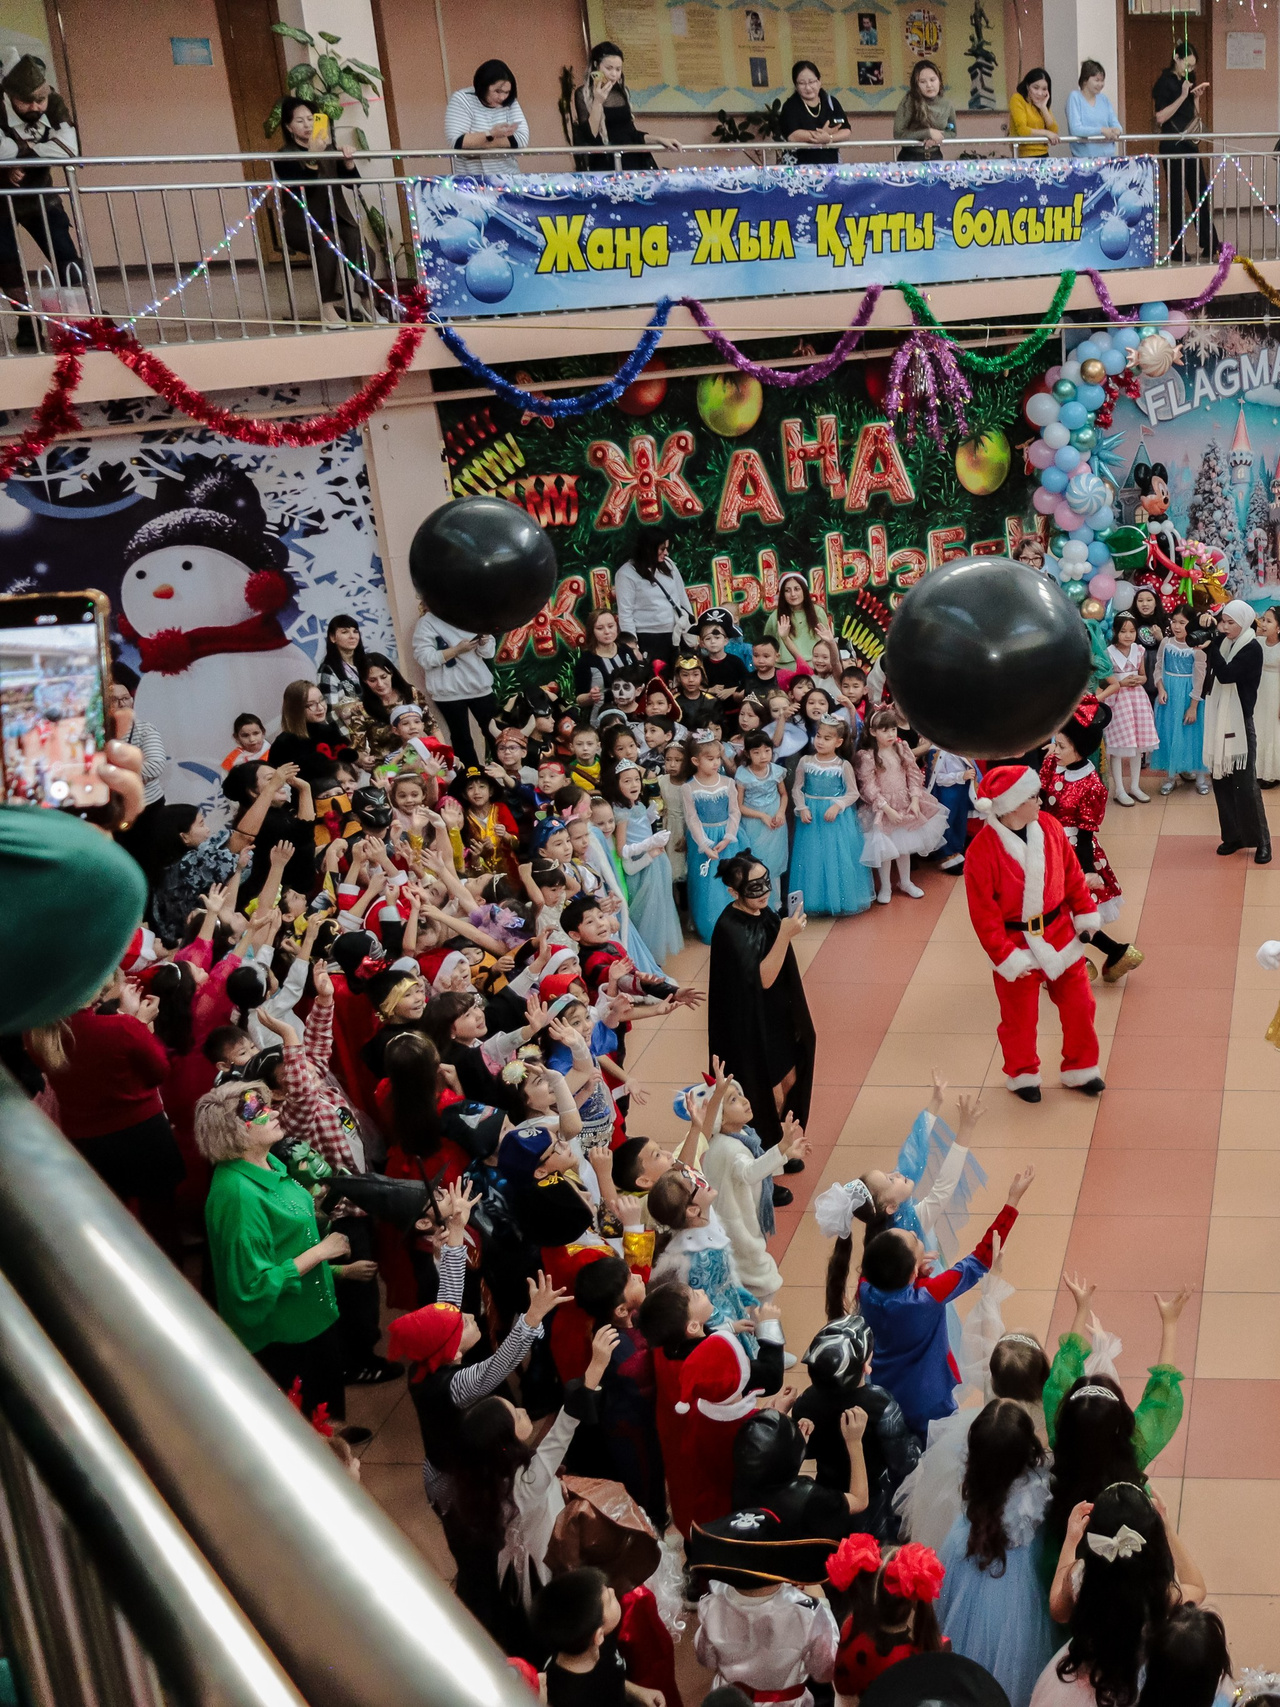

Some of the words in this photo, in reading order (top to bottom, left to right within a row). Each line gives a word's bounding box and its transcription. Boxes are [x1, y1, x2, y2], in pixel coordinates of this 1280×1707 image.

[535, 213, 670, 278] Жаңа
[691, 207, 796, 266] Жыл
[815, 203, 935, 267] Құтты
[952, 192, 1084, 250] болсын!
